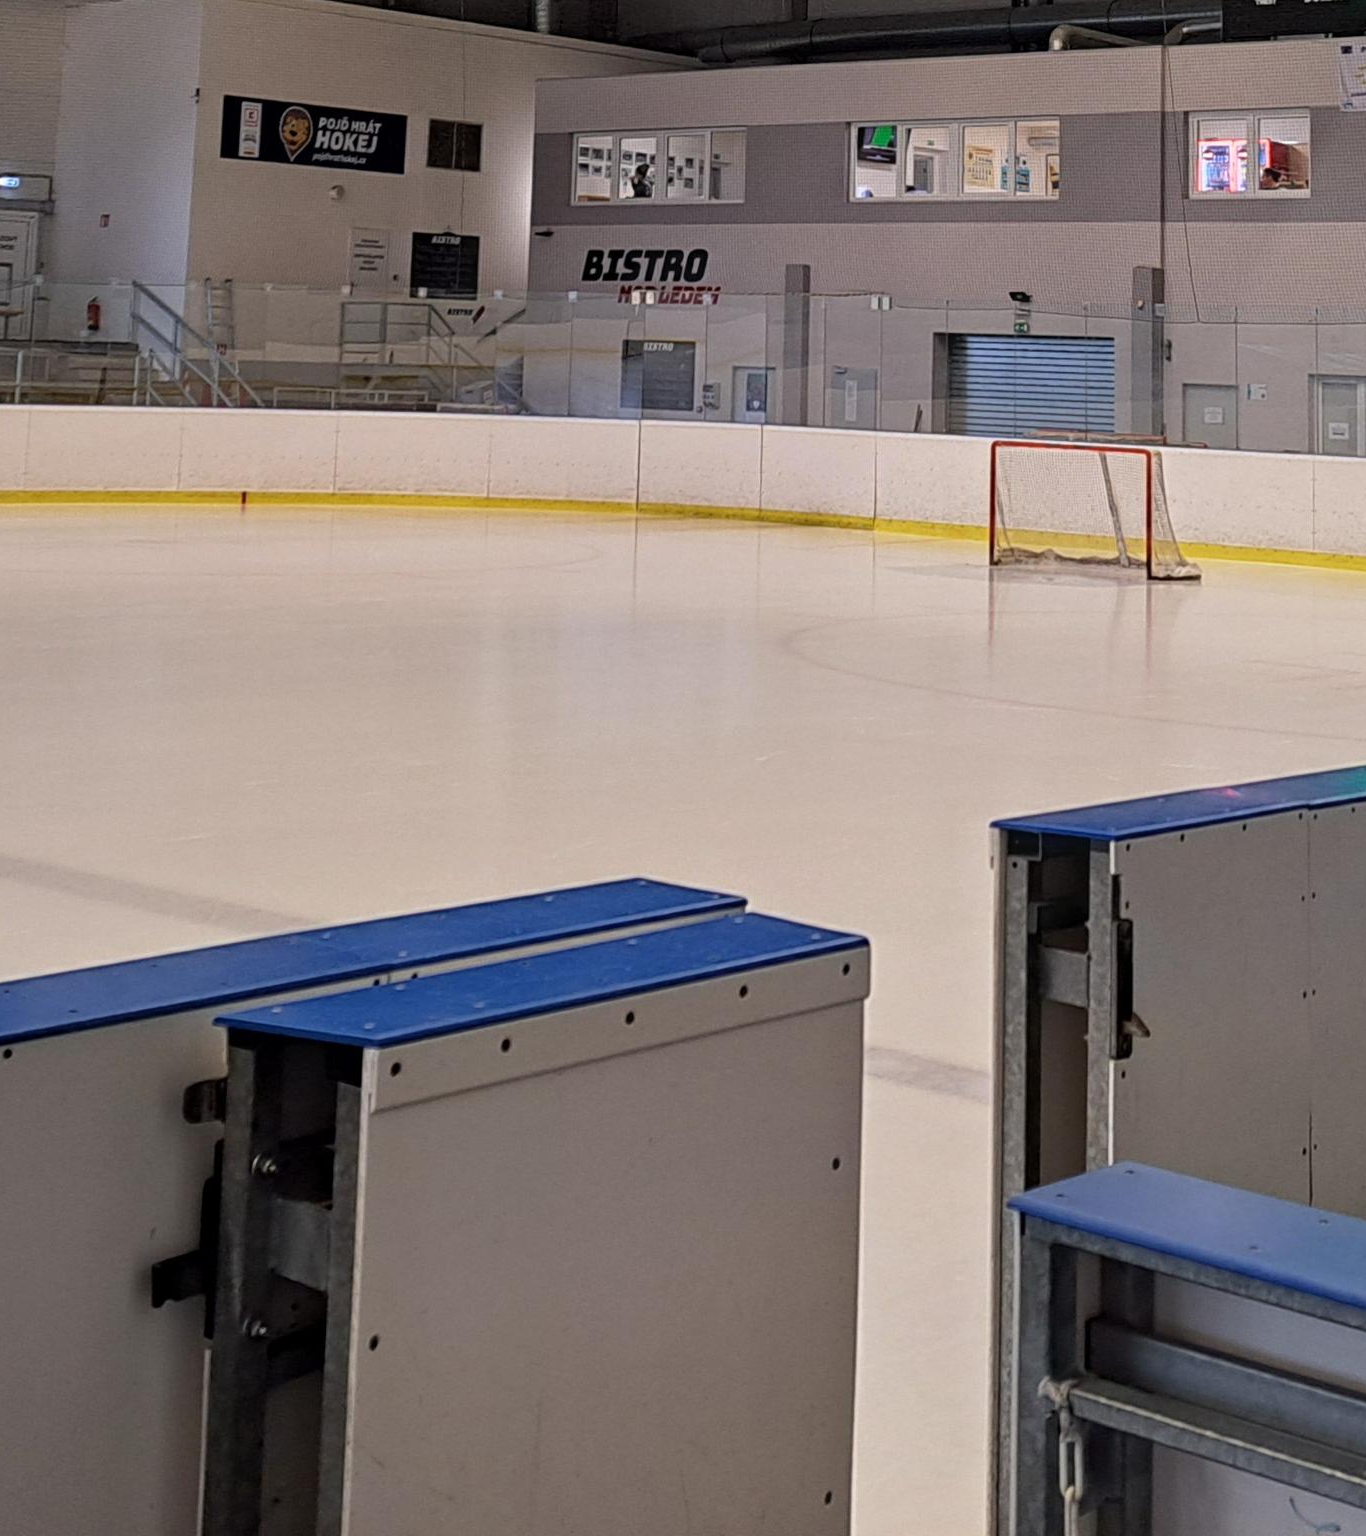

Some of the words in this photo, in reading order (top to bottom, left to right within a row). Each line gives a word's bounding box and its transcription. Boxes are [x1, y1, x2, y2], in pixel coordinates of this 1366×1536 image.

[318, 116, 350, 131] POJĎ
[350, 120, 382, 135] HRÁT
[314, 130, 379, 154] HOKEJ
[582, 248, 709, 282] BISTRO
